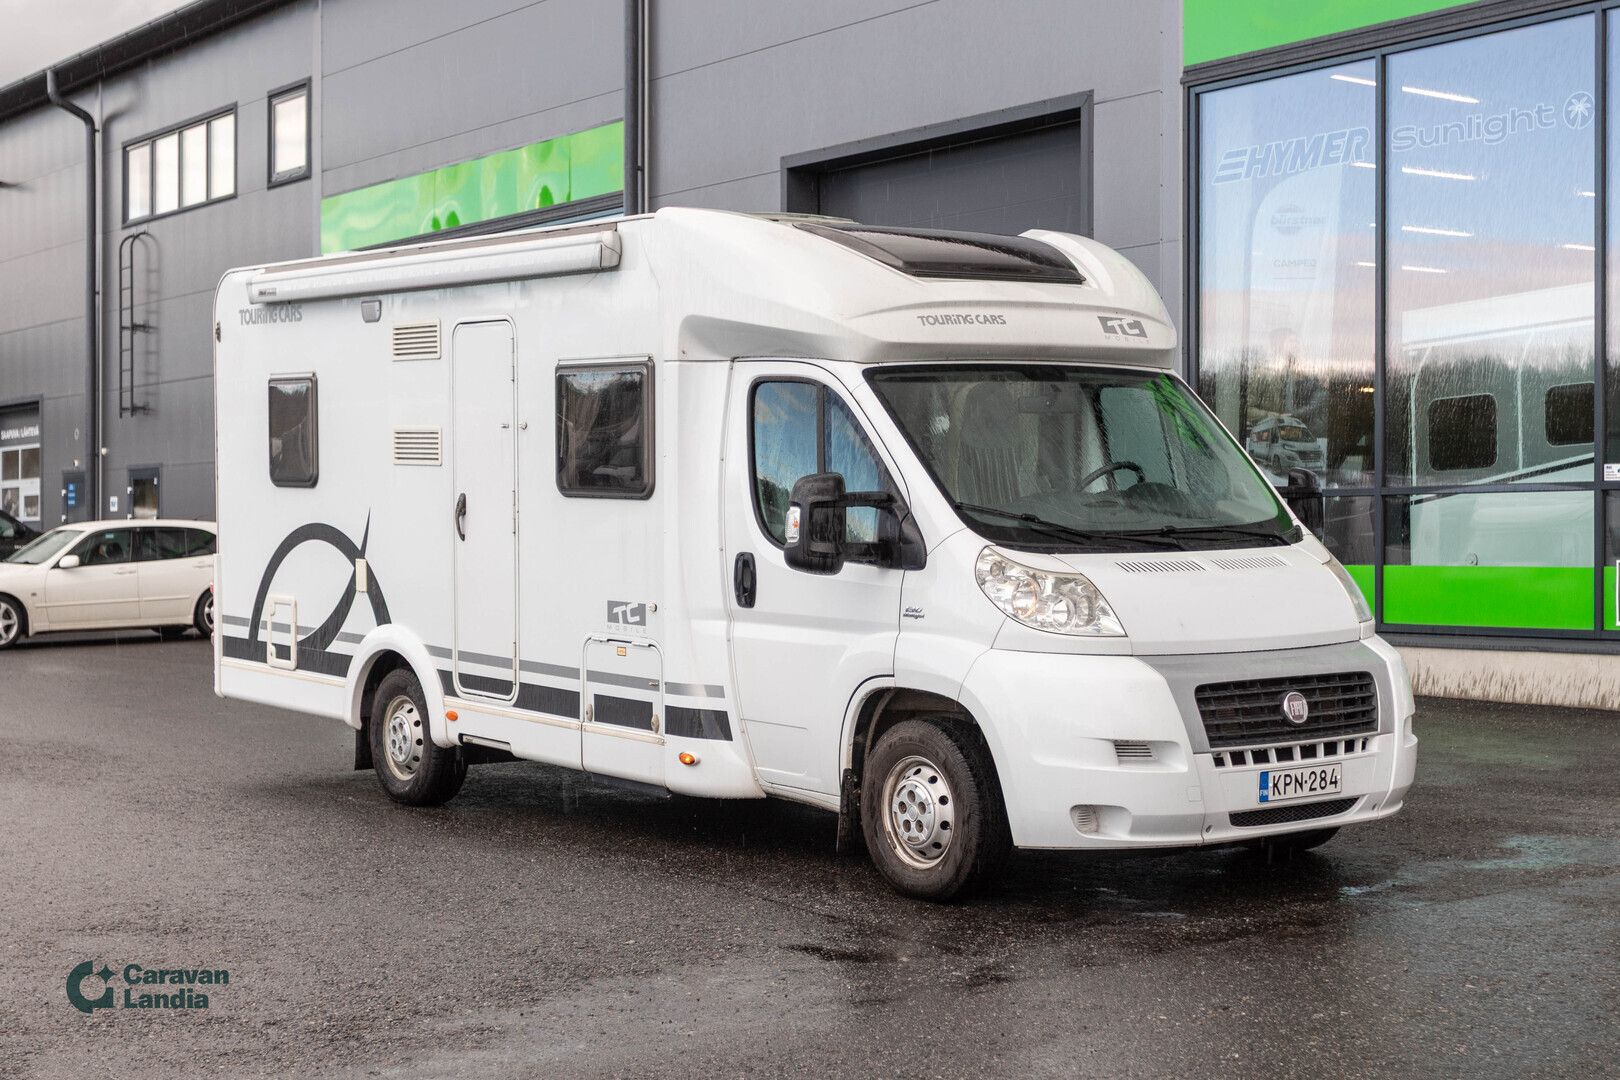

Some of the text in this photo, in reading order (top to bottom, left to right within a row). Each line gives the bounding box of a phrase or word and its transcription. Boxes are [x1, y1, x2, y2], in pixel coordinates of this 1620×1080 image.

[1391, 103, 1556, 152] Sunlight
[1241, 126, 1371, 182] HYMER
[278, 303, 303, 324] CARS
[975, 313, 1007, 326] CARS
[611, 601, 641, 625] TC
[1272, 768, 1339, 797] KPN-284
